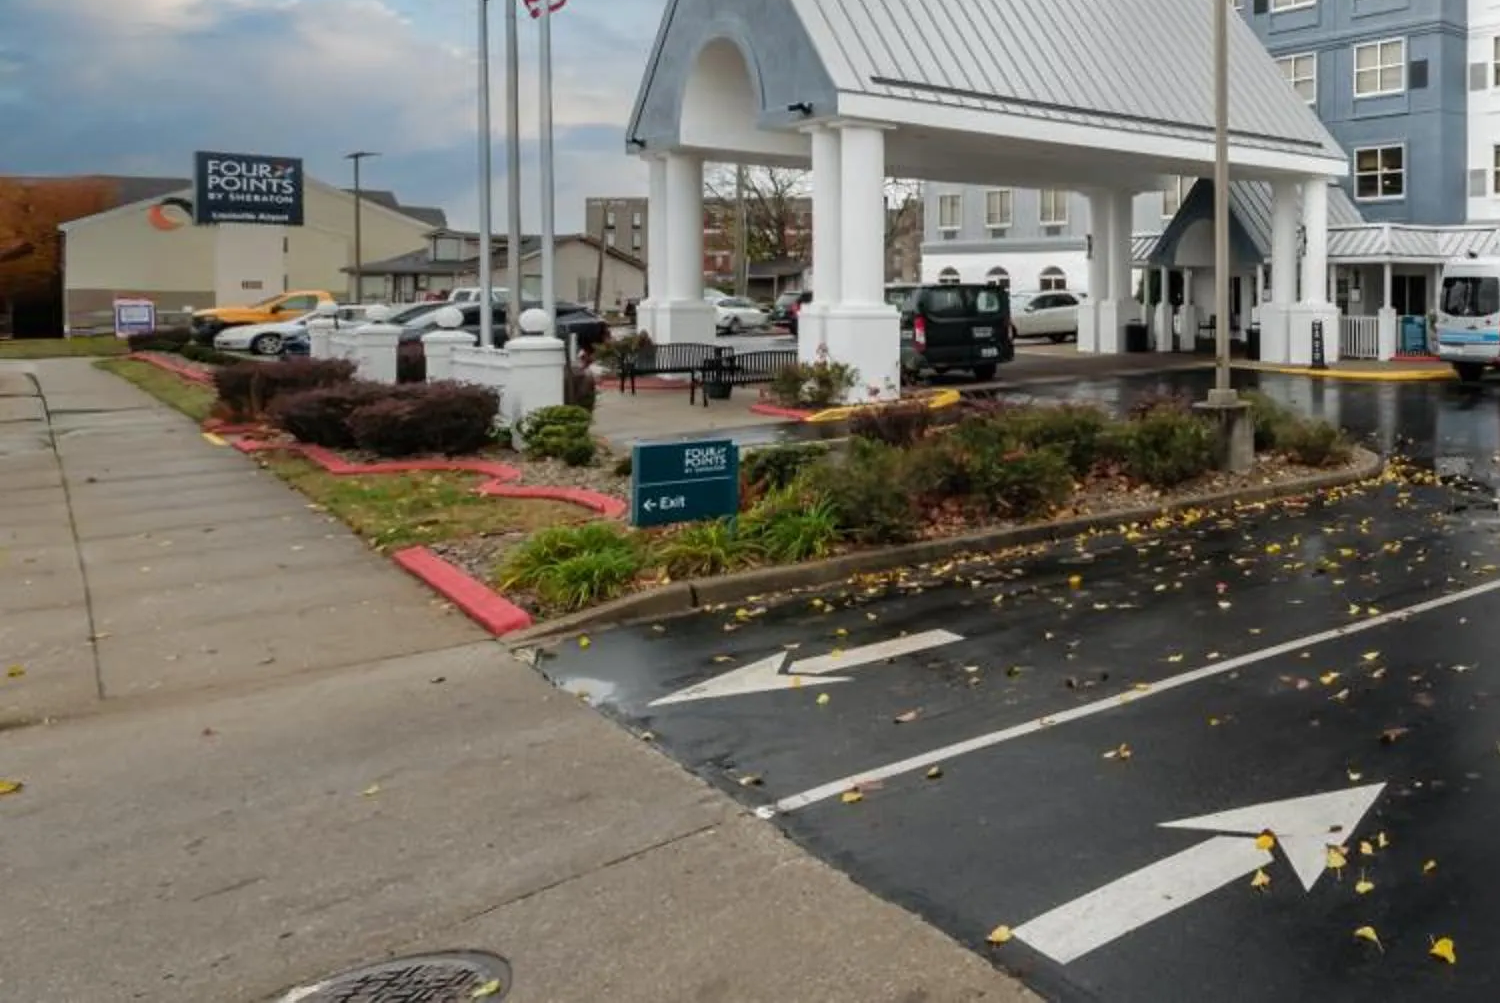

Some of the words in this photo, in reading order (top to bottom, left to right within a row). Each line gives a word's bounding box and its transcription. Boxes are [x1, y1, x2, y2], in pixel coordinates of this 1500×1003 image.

[207, 160, 272, 178] FOUR
[207, 176, 294, 194] POINTS
[207, 192, 225, 201] BY
[229, 193, 294, 204] SHERATON
[685, 447, 715, 459] FOUR
[685, 454, 727, 468] POINTS
[660, 495, 685, 509] Exit
